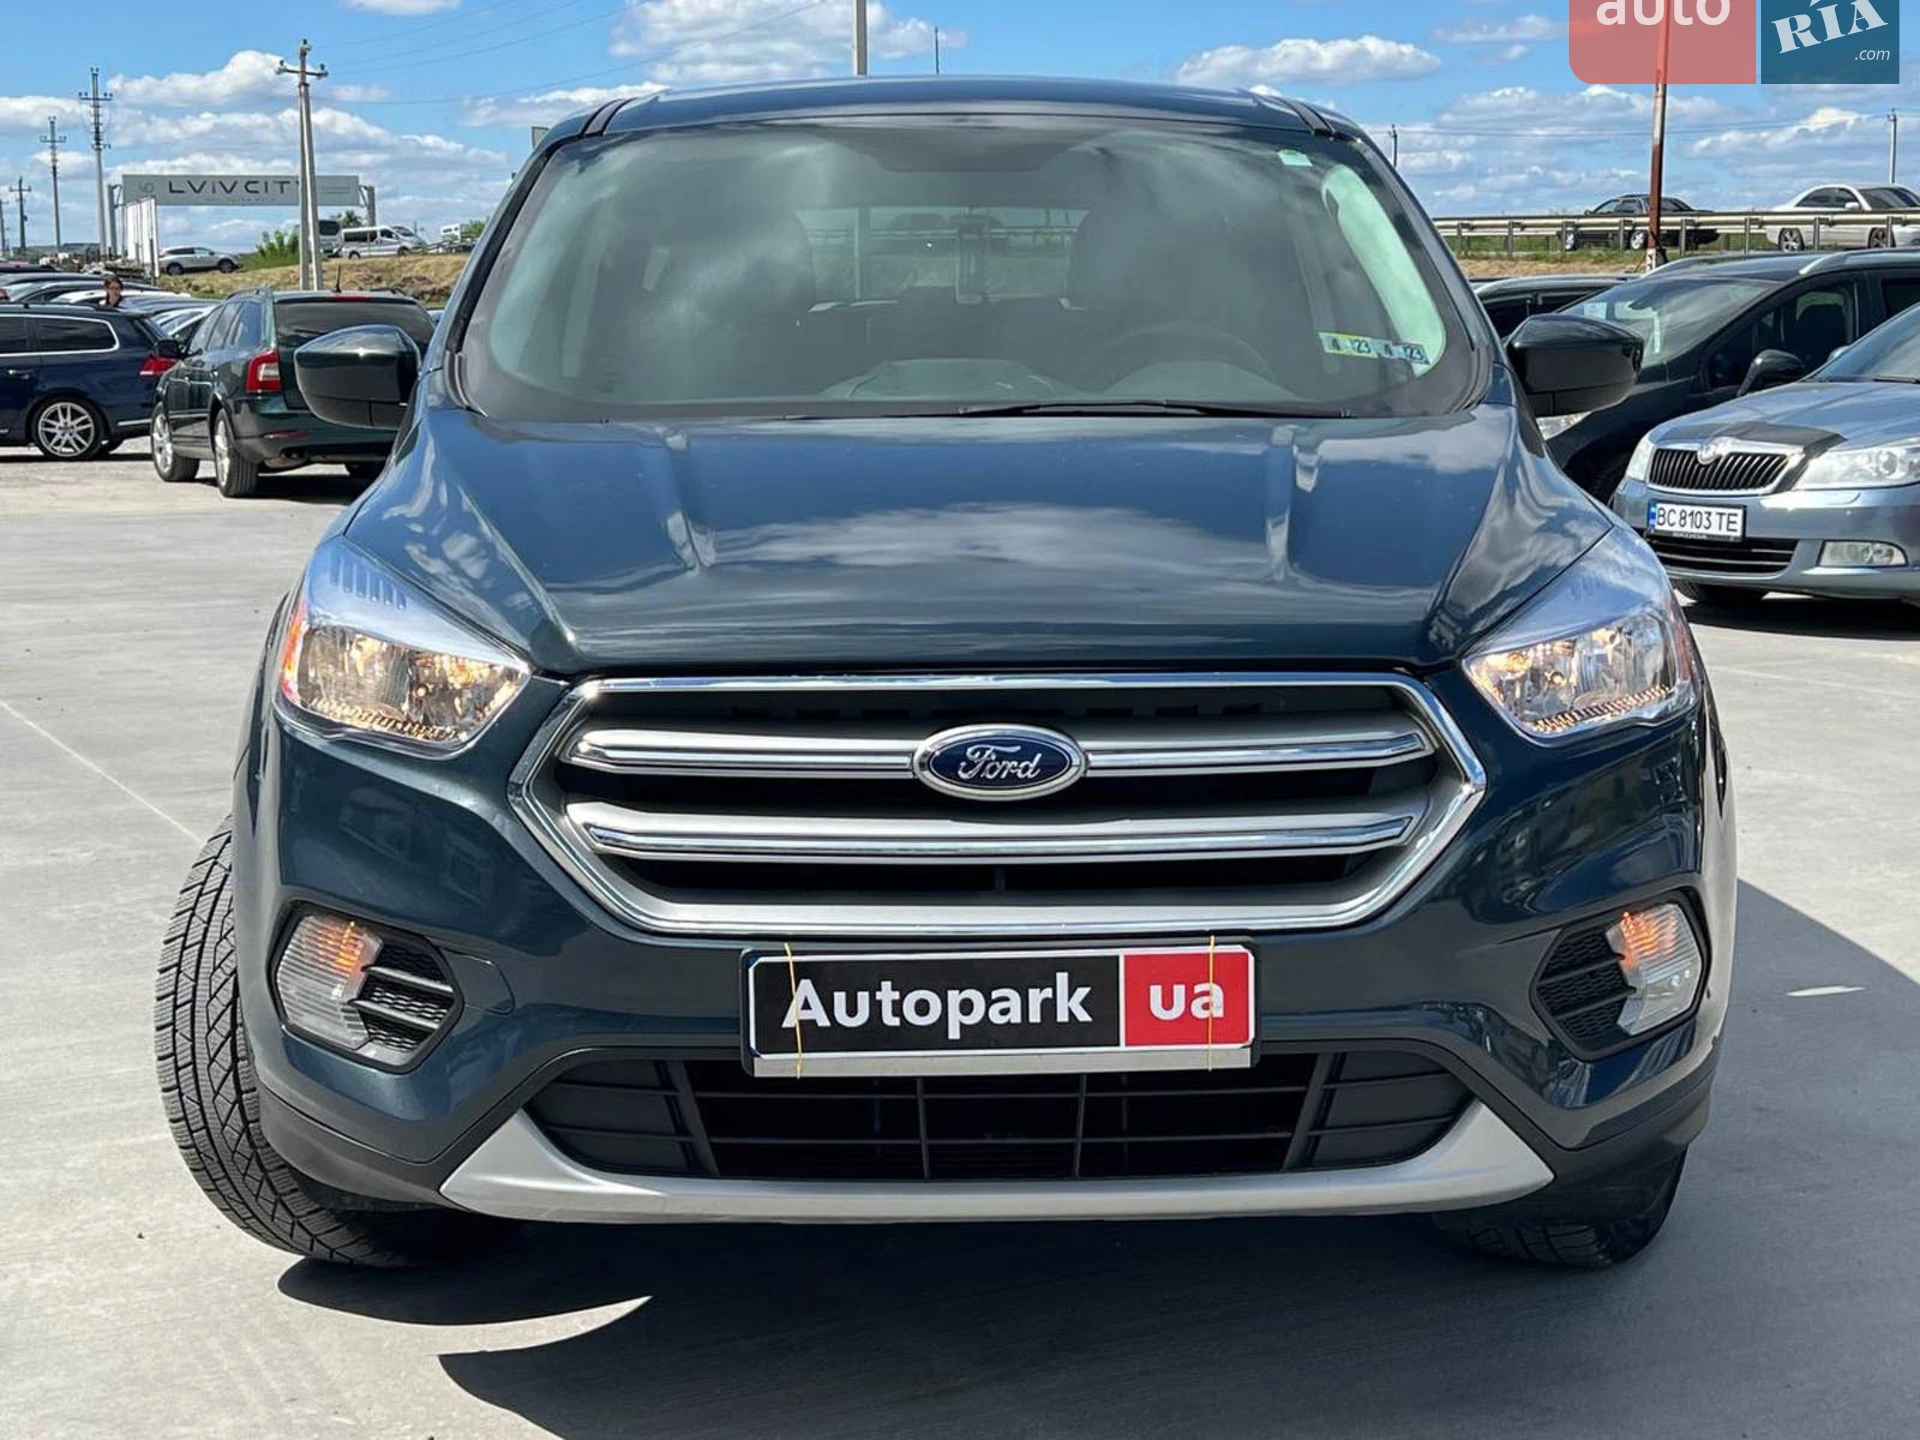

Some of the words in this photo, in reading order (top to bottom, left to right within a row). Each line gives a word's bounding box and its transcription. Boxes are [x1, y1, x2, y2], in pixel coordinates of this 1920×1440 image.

[168, 179, 299, 195] LVIVCIT
[1657, 507, 1677, 527] BC
[1679, 509, 1712, 530] 8103
[1716, 512, 1738, 532] TE
[957, 744, 1043, 780] Ford
[781, 971, 1092, 1039] Autopark
[1149, 980, 1225, 1021] ua
